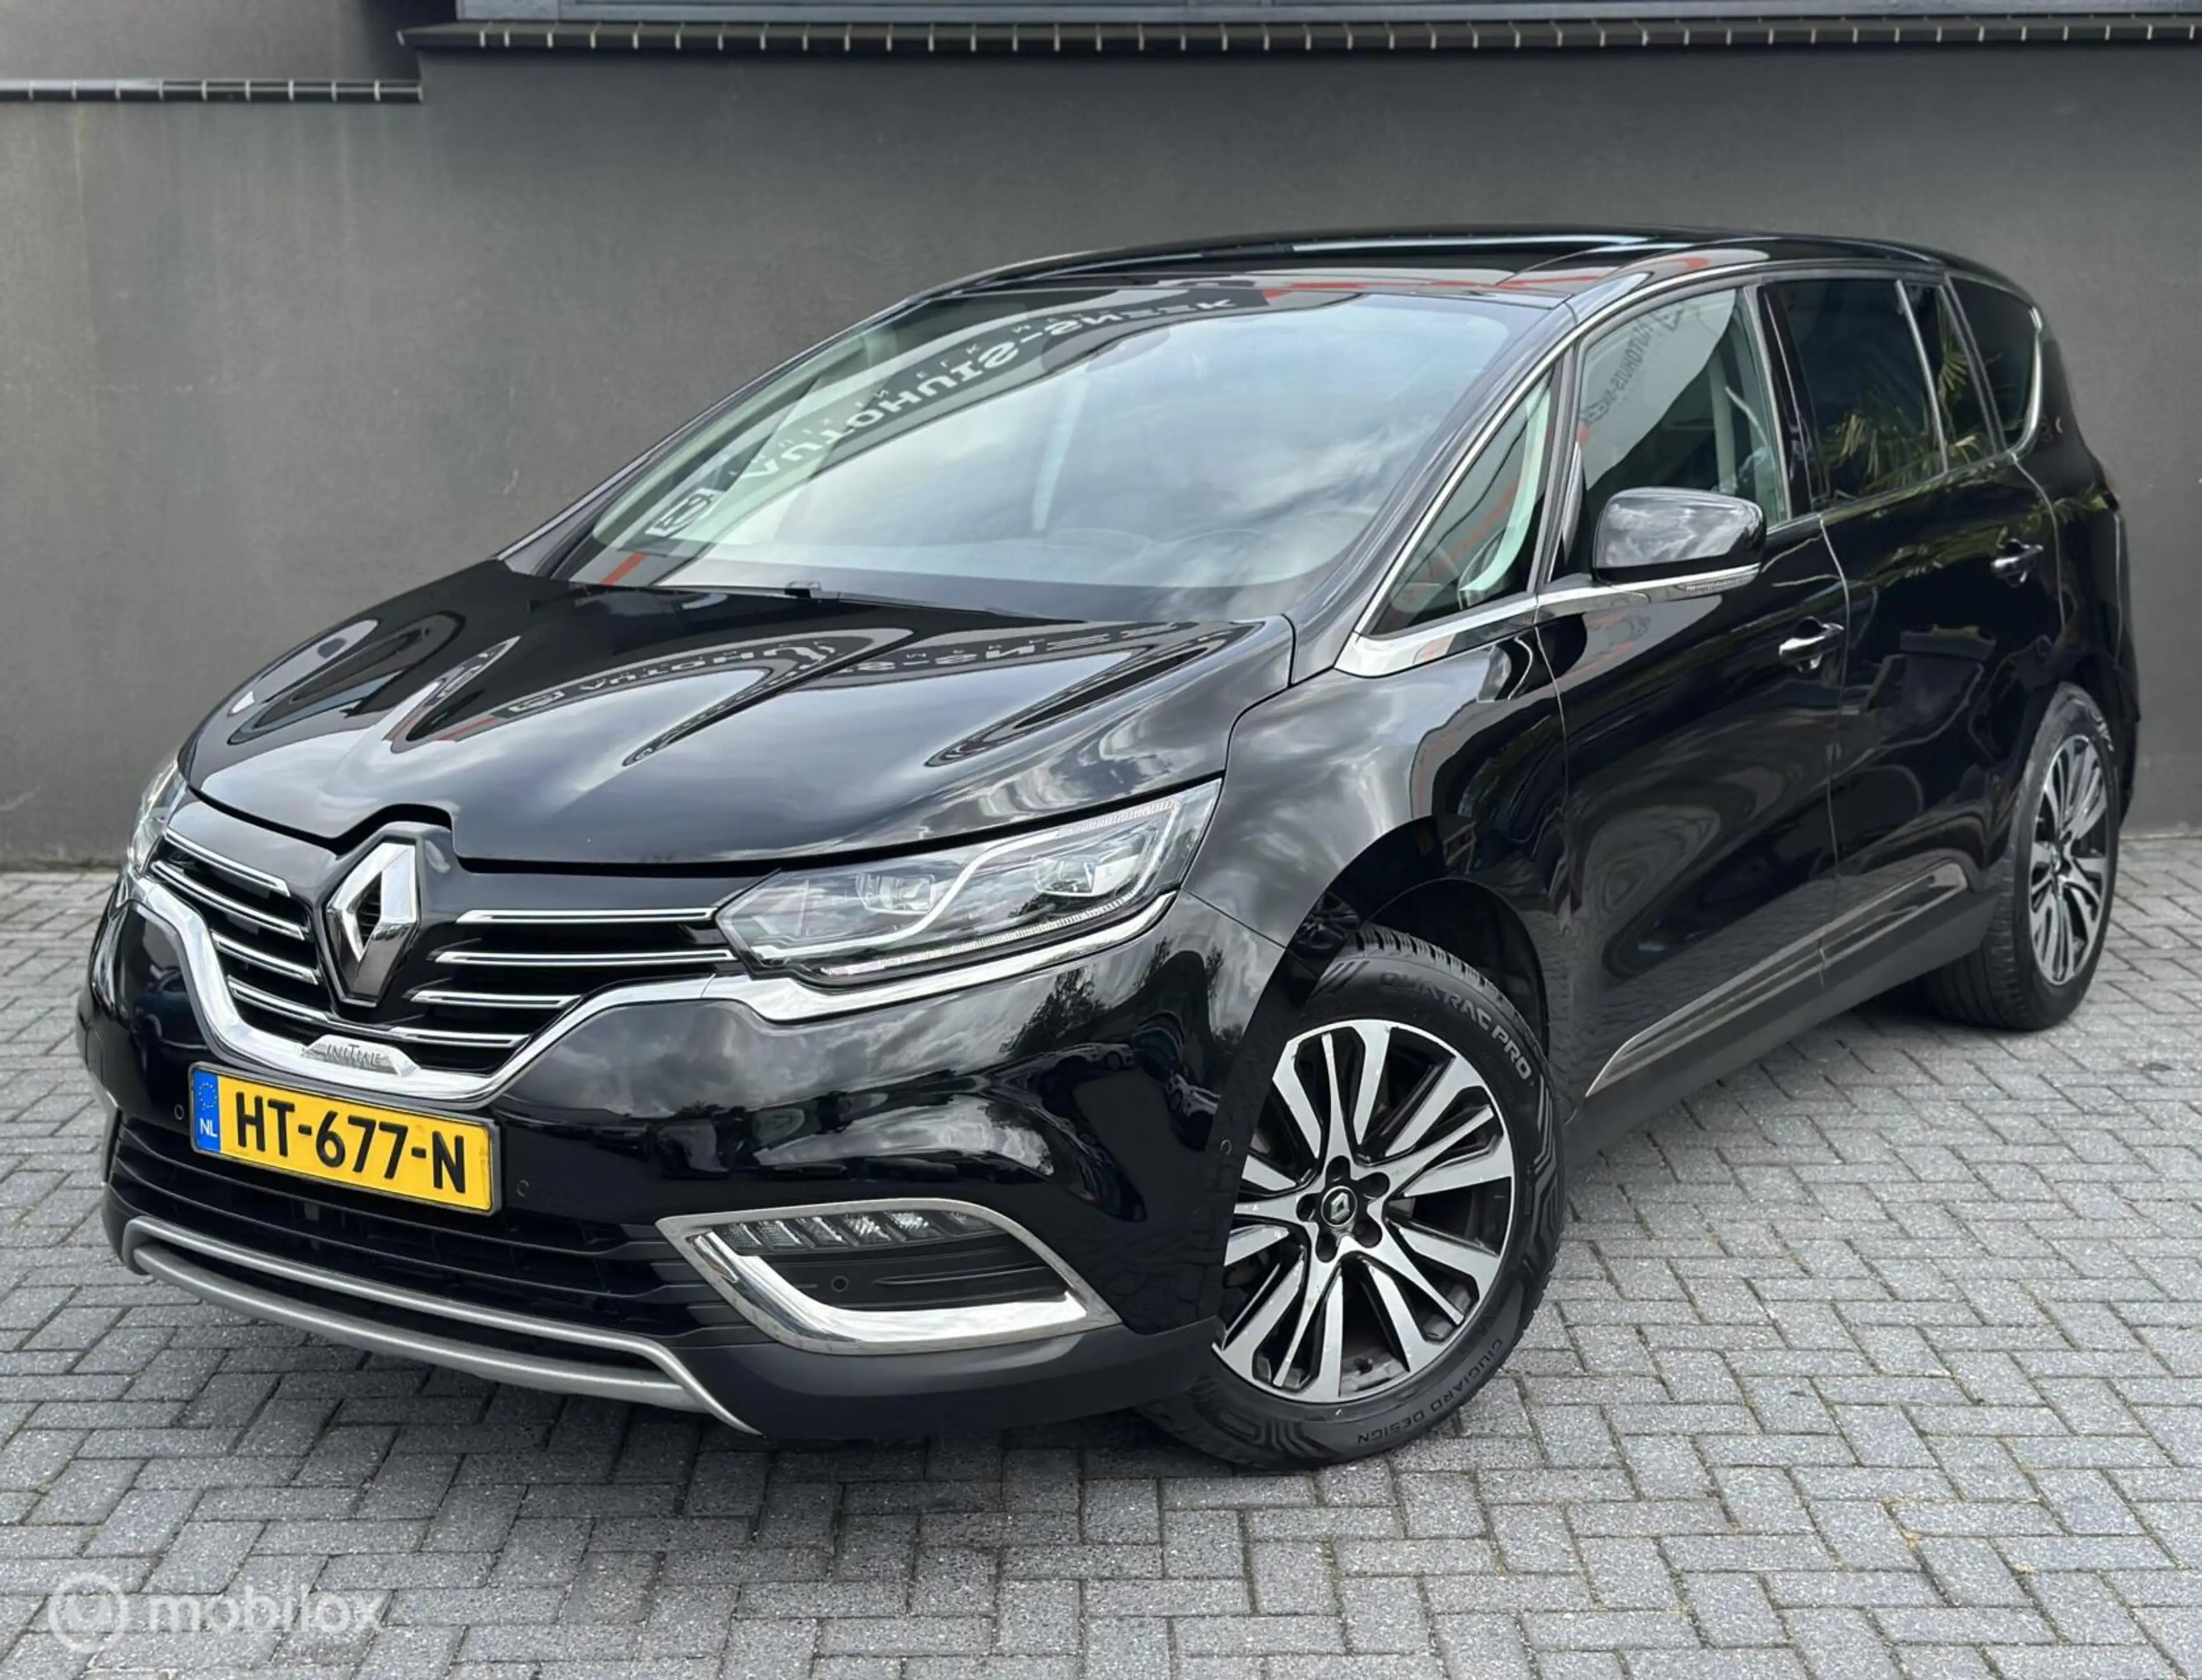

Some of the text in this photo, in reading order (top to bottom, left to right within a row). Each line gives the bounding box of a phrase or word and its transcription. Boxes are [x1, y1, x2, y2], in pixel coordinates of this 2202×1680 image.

[1492, 1024, 1532, 1080] PRO
[199, 1118, 218, 1138] NL
[236, 1092, 466, 1194] HT-677-N
[1357, 1410, 1425, 1444] DESIGN
